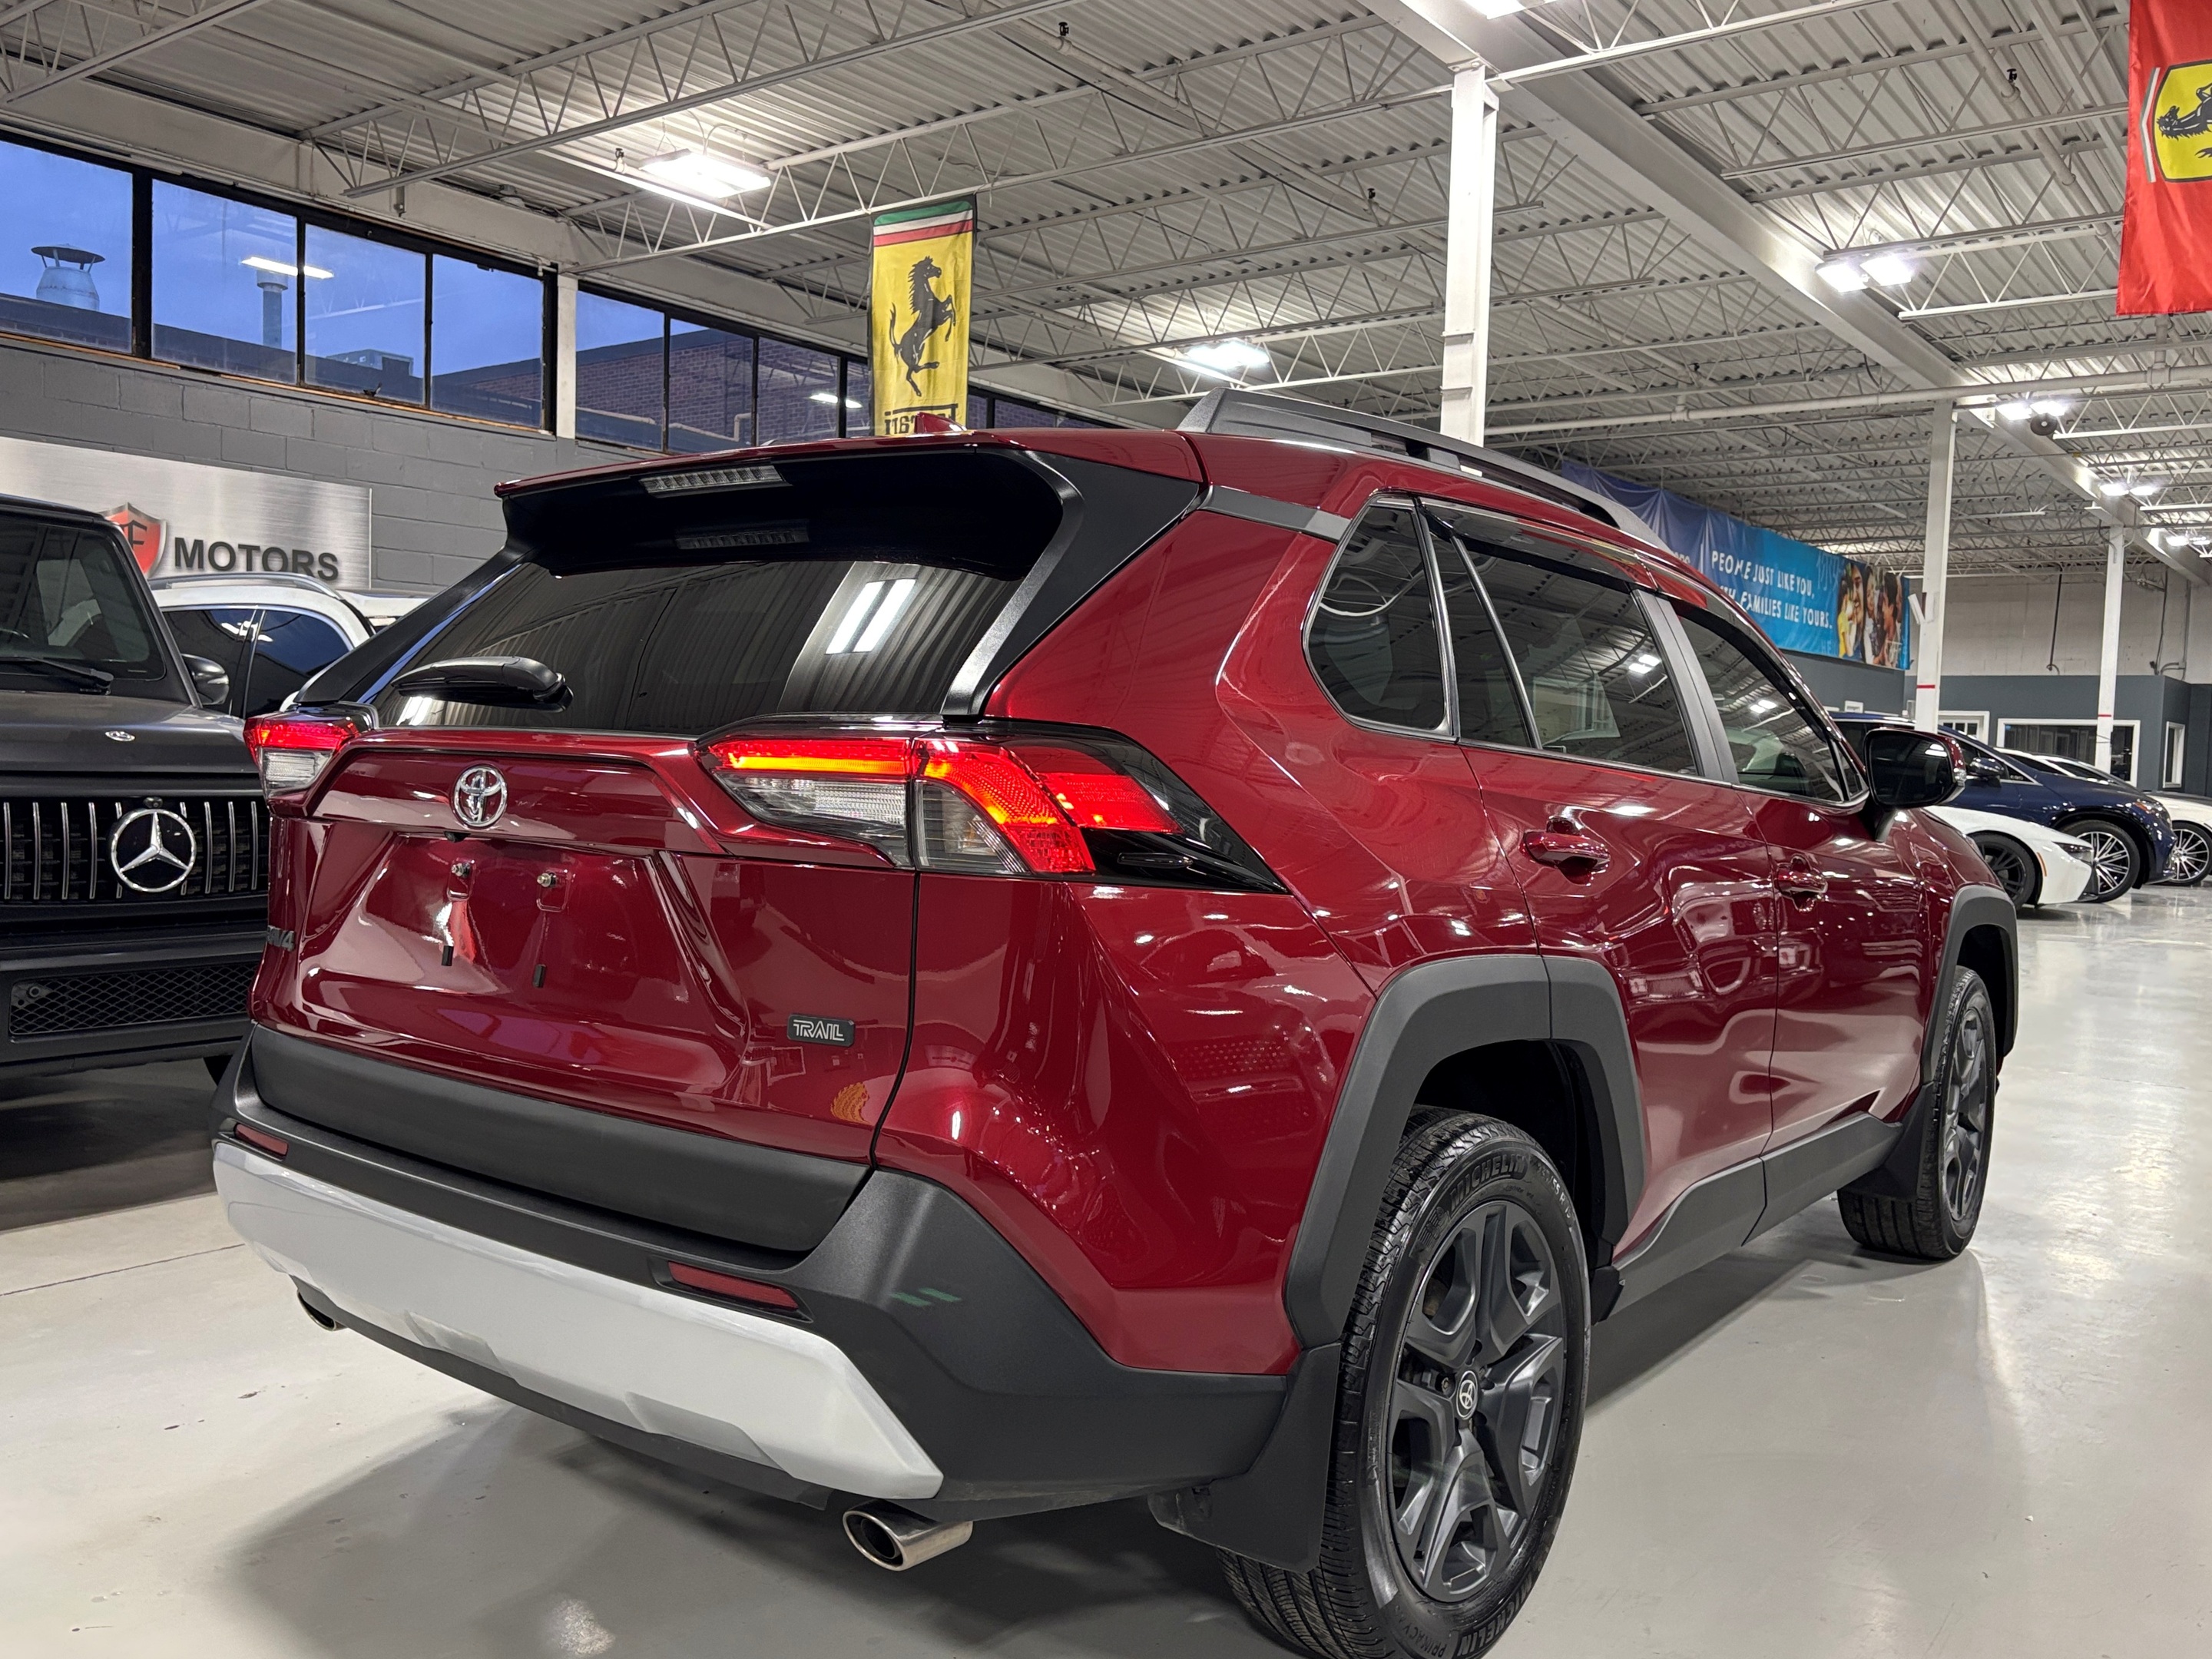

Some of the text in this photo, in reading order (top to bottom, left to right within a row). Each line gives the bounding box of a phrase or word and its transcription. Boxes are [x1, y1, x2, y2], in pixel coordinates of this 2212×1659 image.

[174, 536, 339, 581] MOTORS
[1753, 564, 1774, 586] JUST
[1777, 570, 1795, 592] LIKE
[1740, 591, 1782, 619] FAMILIES
[1784, 602, 1799, 623] LIKE
[793, 1019, 845, 1041] TRAIL
[1449, 1154, 1528, 1211] MICHELIN
[1456, 1575, 1534, 1657] MICHELIN
